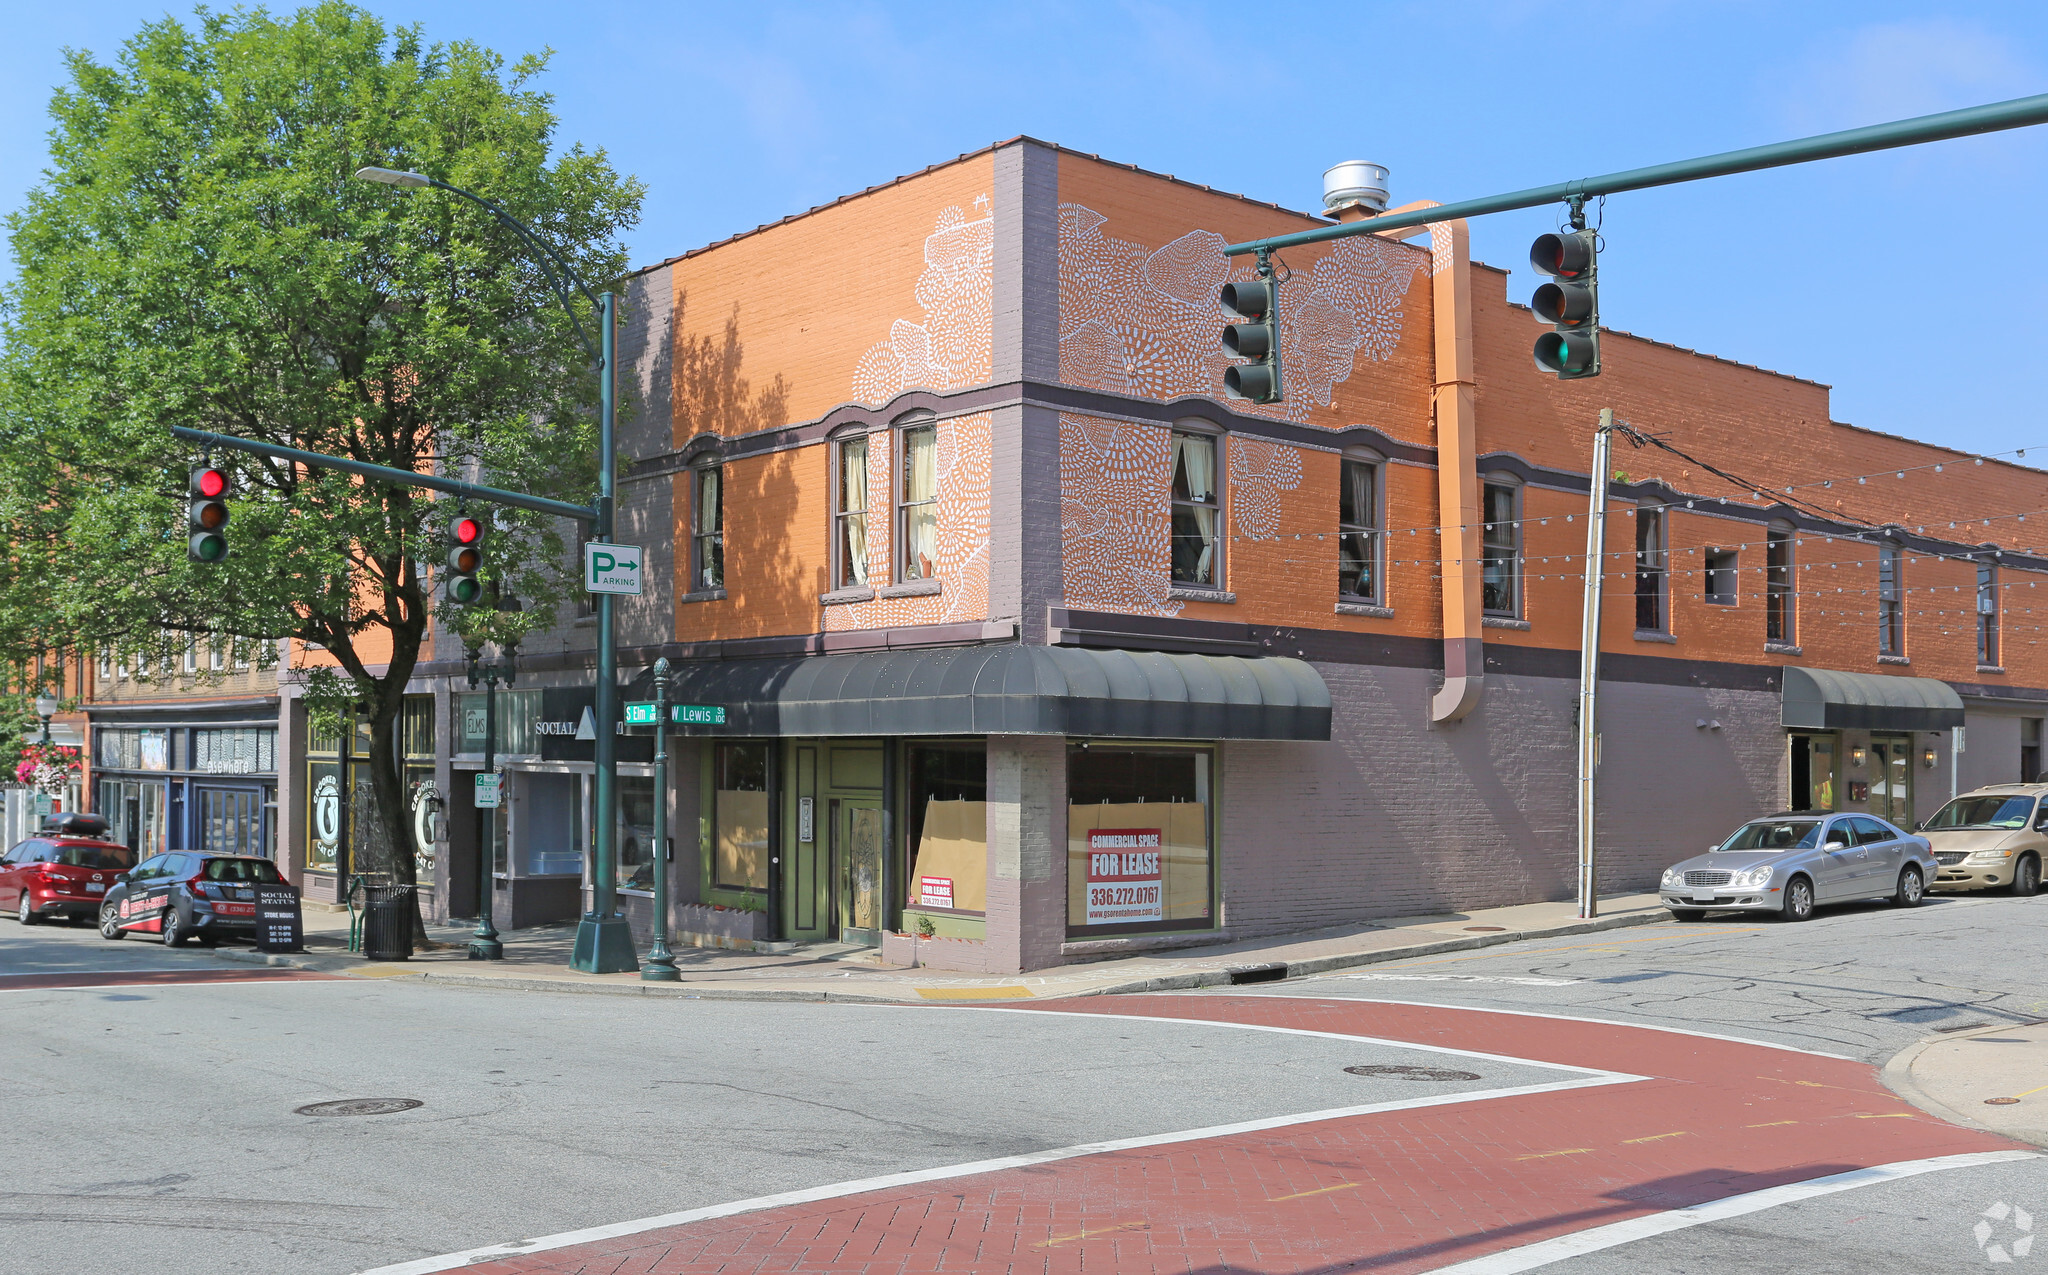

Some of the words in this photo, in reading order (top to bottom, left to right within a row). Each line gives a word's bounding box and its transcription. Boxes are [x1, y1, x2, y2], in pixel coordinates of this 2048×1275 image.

[626, 706, 632, 721] S
[633, 706, 646, 721] Elm
[671, 706, 680, 721] W
[683, 706, 711, 722] Lewis
[717, 707, 725, 715] St
[535, 721, 577, 735] SOCIAL
[207, 758, 249, 775] elsewhere
[477, 775, 483, 785] 2
[411, 780, 436, 811] CROOKE
[317, 841, 327, 855] CAT
[1091, 835, 1138, 849] COMMERCIAL
[1138, 834, 1159, 848] SPACE
[415, 851, 427, 868] CAT
[1091, 853, 1119, 876] FOR
[1122, 852, 1159, 875] LEASE
[922, 885, 933, 895] FOR
[934, 886, 951, 896] LEASE
[1091, 886, 1159, 906] 336.272.0767
